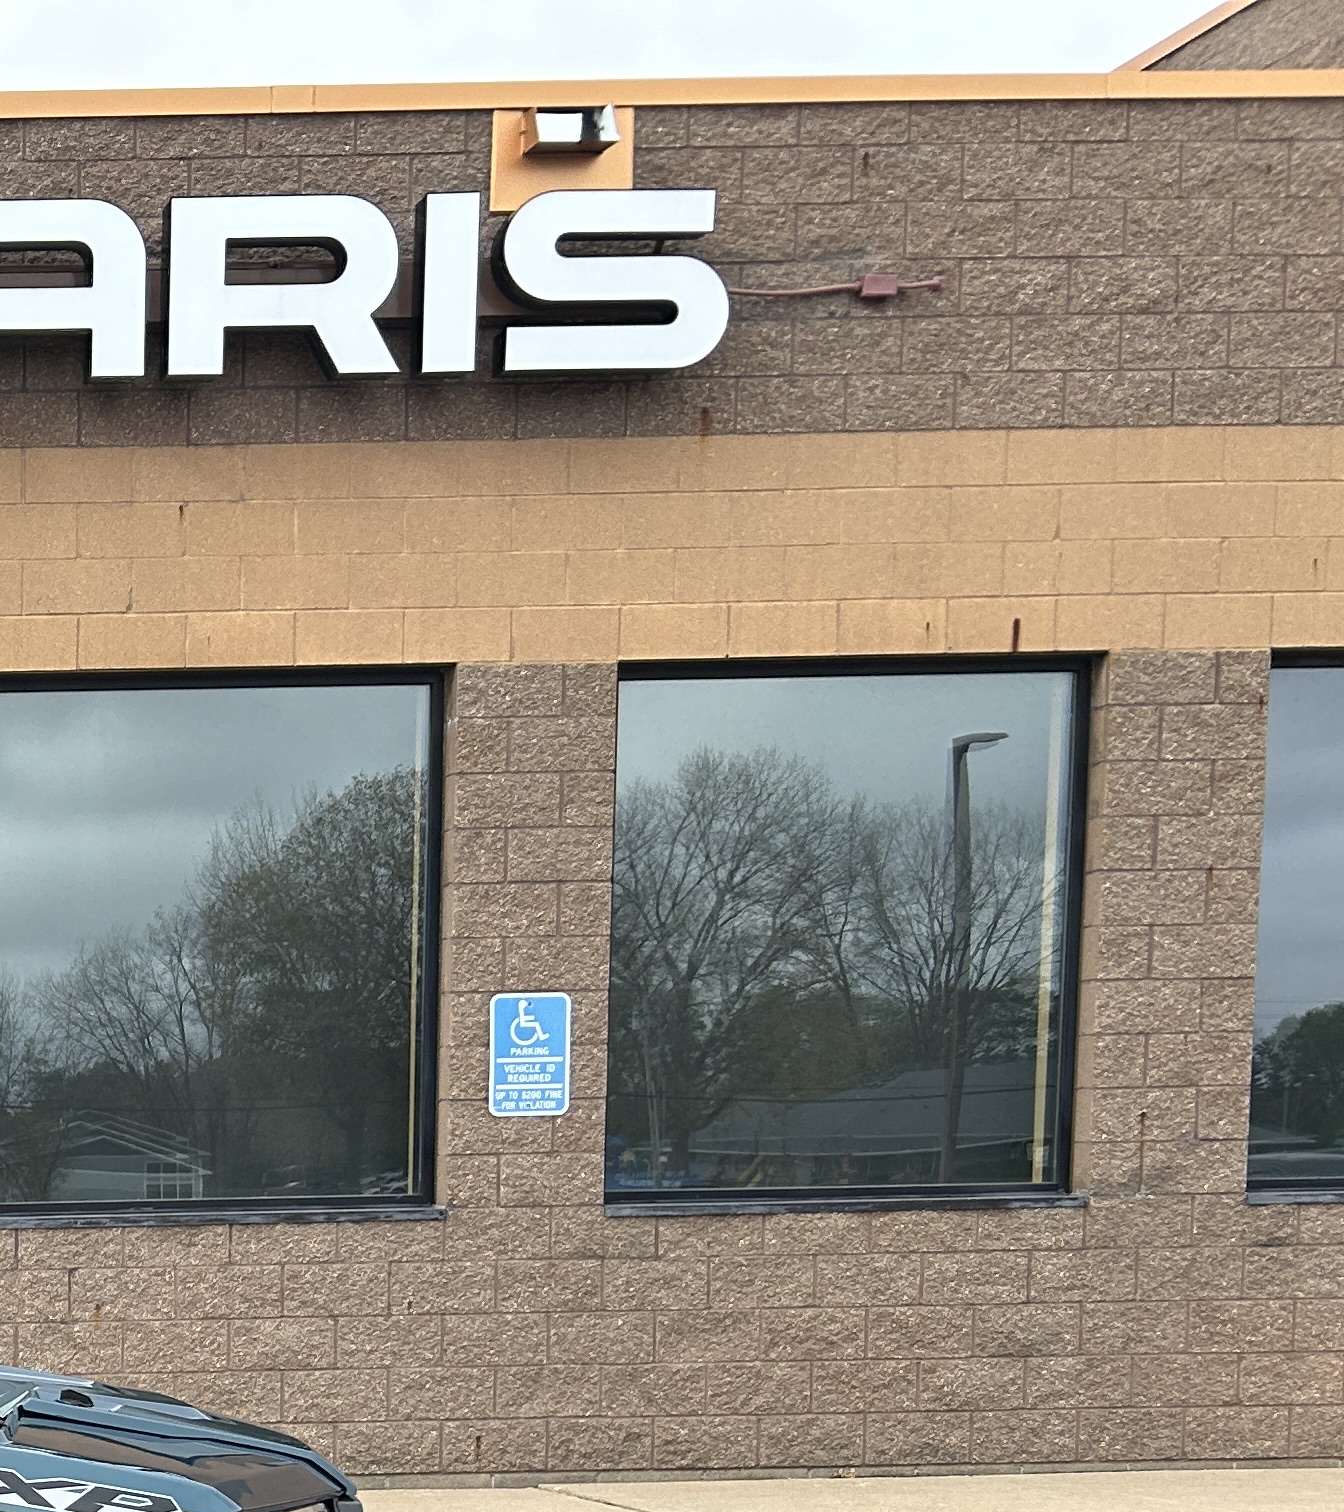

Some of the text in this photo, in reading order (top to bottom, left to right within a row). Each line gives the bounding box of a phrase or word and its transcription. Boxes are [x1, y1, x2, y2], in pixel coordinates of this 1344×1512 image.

[509, 1046, 550, 1056] PARKING
[503, 1063, 556, 1073] VEHICLE ID
[507, 1073, 552, 1083] REQUIRED
[495, 1090, 563, 1100] UP TO $200 FINE
